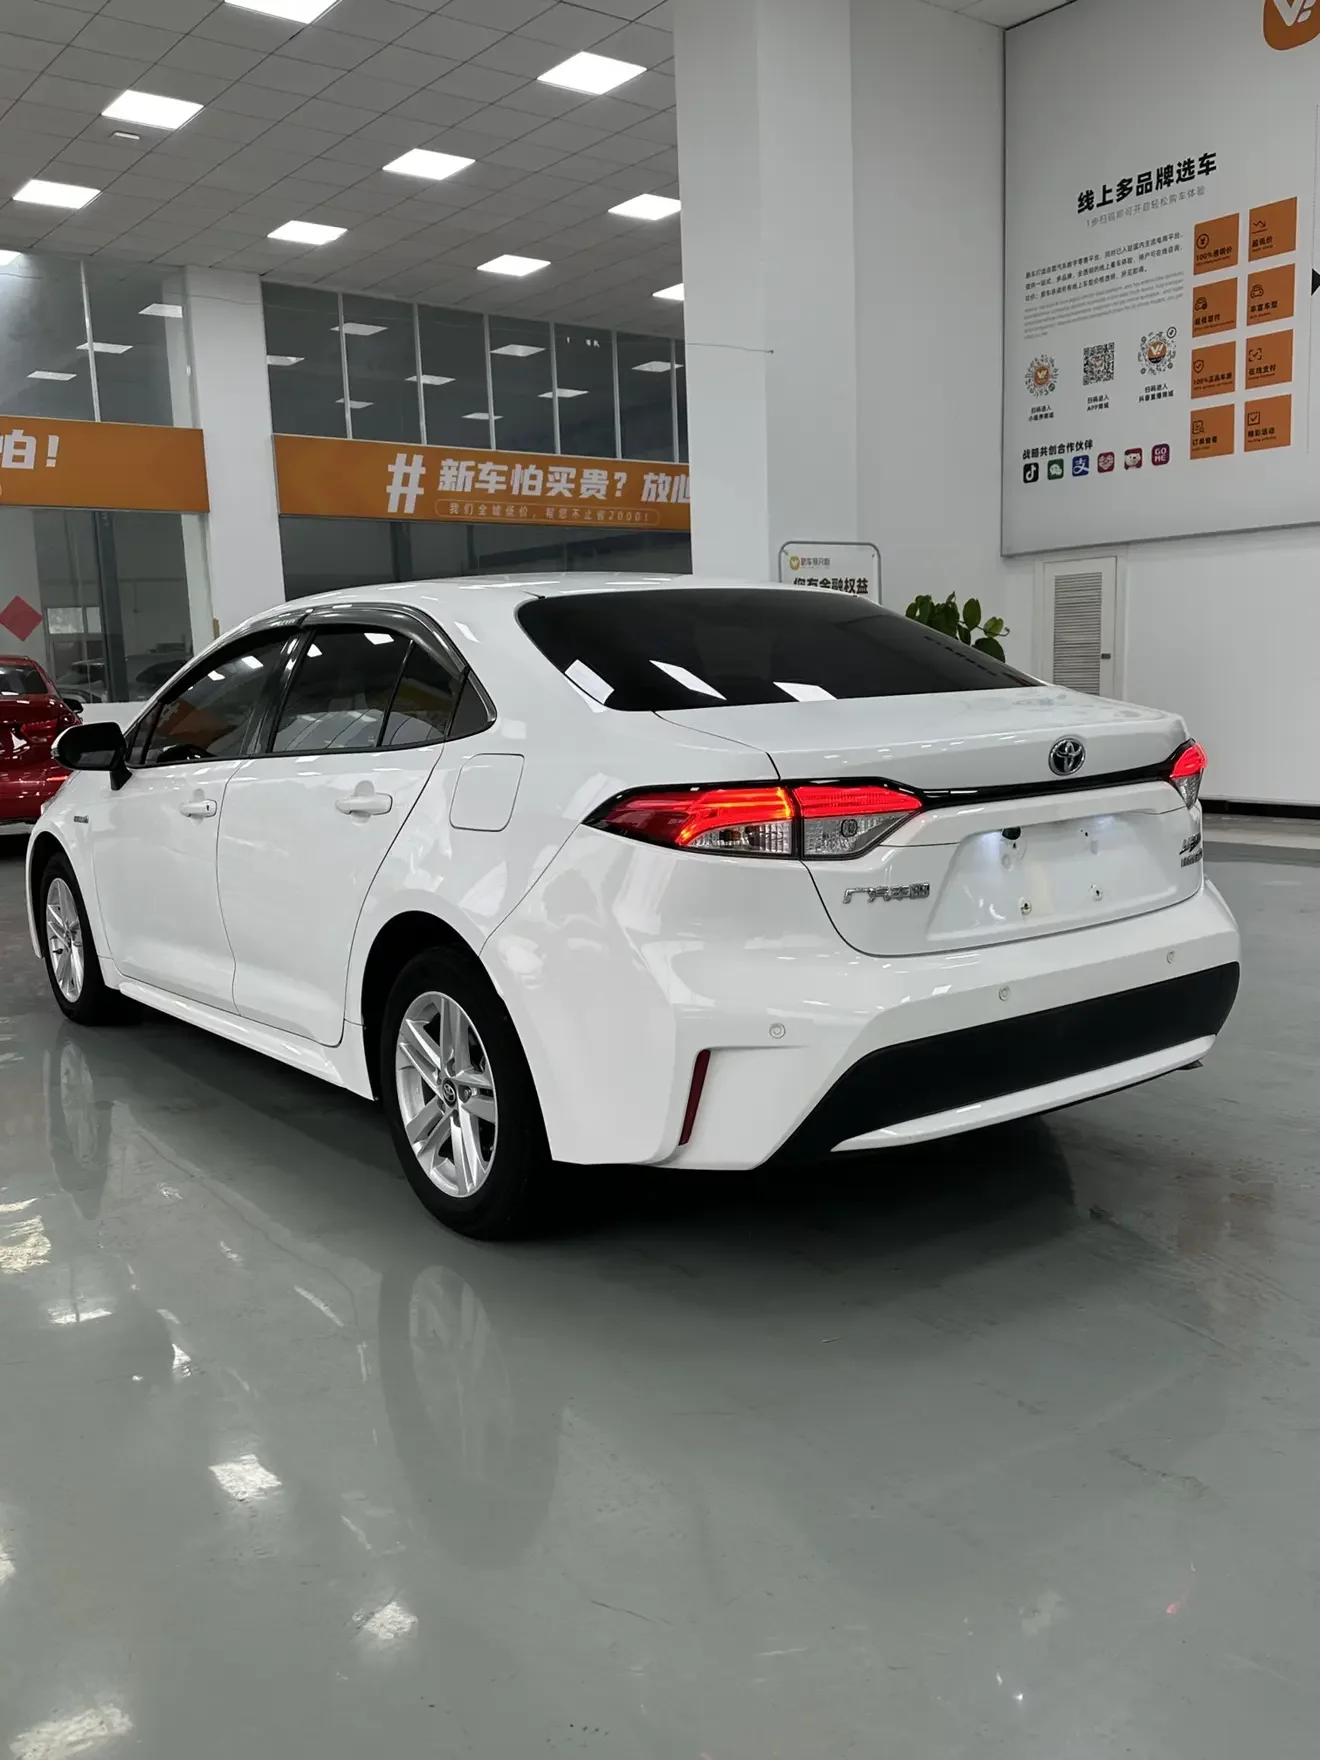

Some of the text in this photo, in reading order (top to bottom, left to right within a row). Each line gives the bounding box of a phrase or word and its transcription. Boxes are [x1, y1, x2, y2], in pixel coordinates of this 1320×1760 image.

[1077, 152, 1217, 214] 线上多品牌选车
[1248, 364, 1277, 377] 在线支付
[1022, 438, 1093, 461] 战略共创合作伙伴
